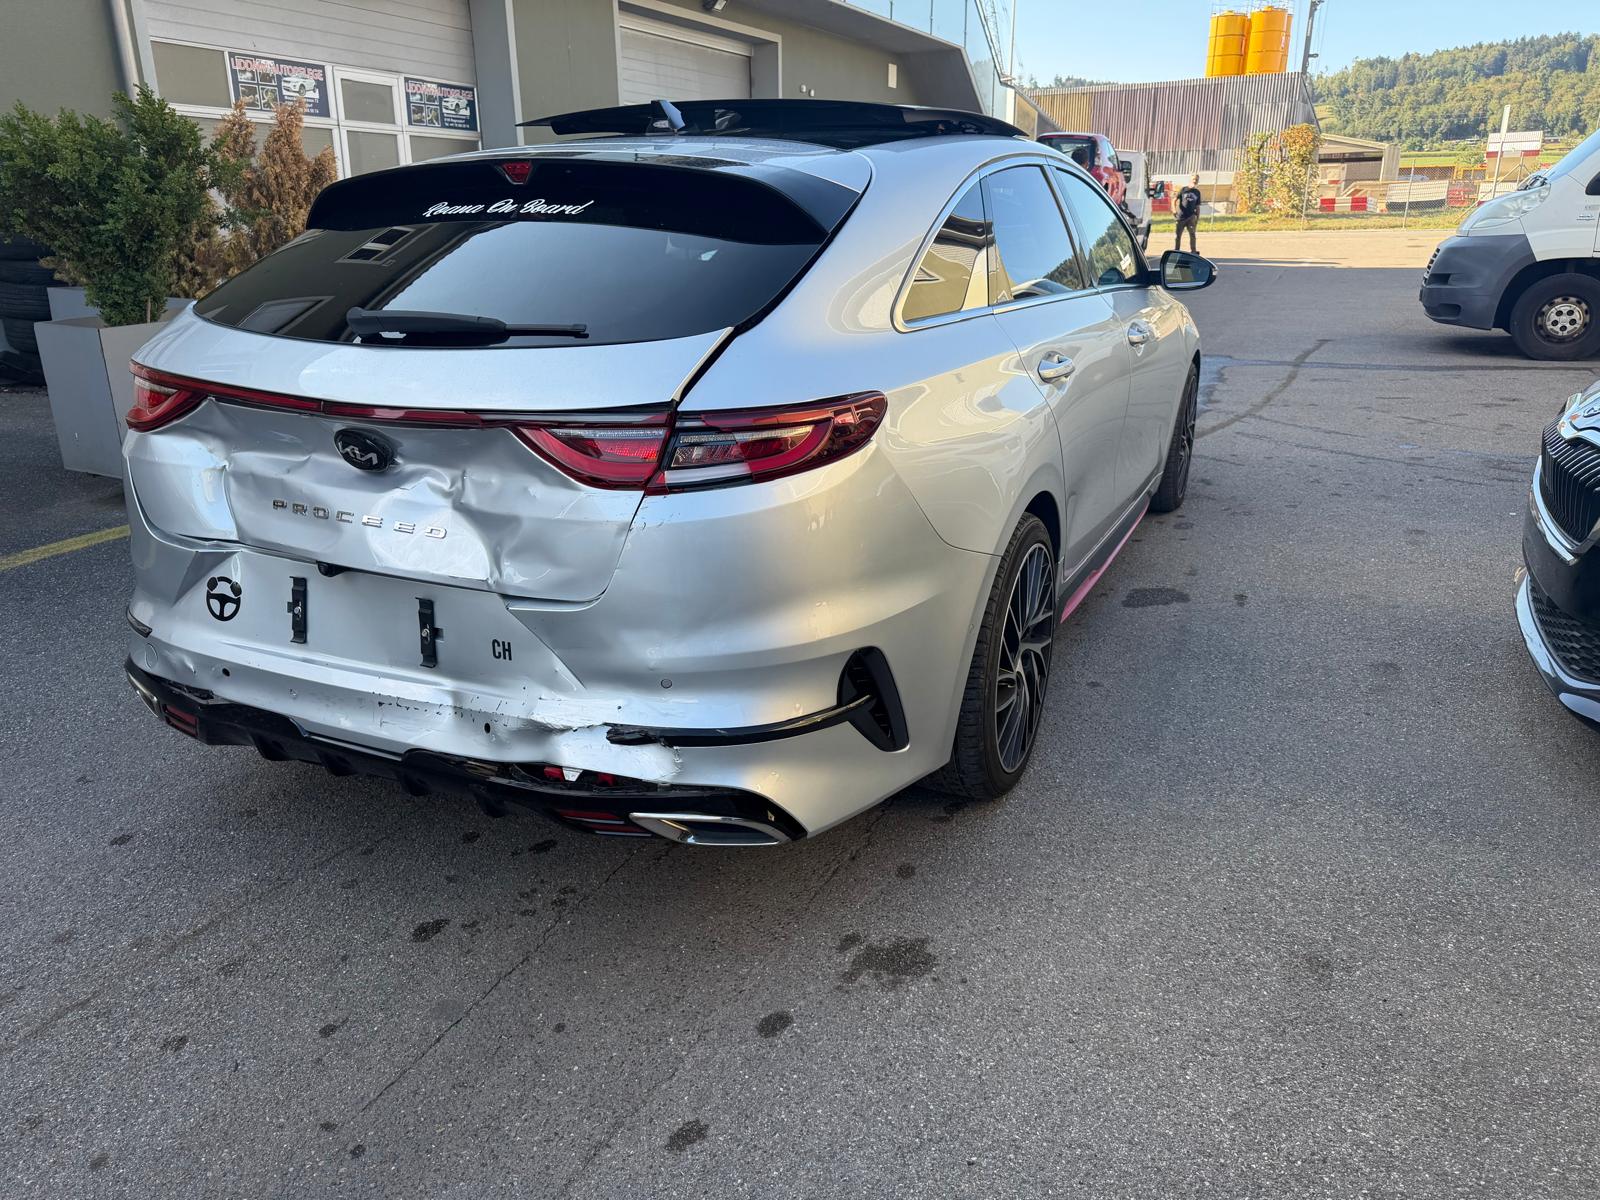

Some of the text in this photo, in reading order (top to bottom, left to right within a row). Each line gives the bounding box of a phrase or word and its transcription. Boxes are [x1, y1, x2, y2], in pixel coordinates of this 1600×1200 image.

[487, 199, 518, 213] On
[520, 199, 594, 214] Board
[273, 499, 448, 540] PROCEED
[492, 639, 512, 661] CH
